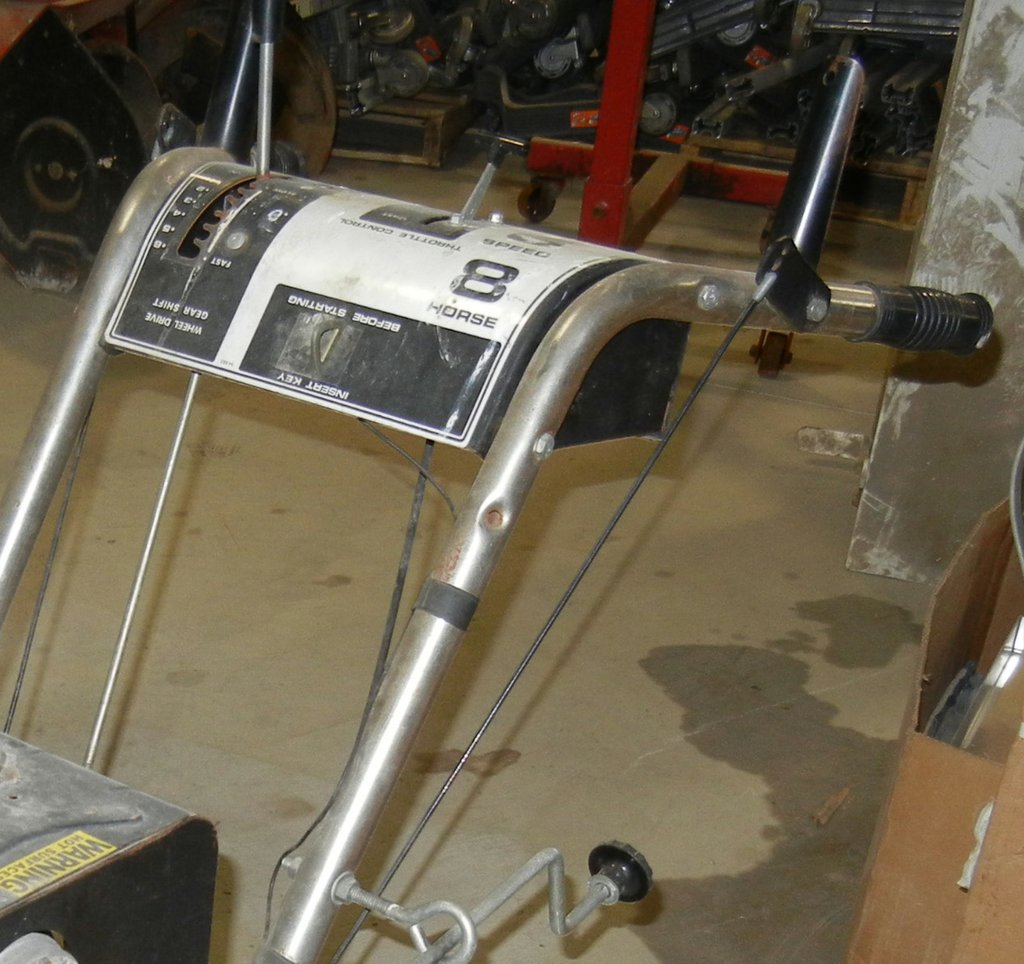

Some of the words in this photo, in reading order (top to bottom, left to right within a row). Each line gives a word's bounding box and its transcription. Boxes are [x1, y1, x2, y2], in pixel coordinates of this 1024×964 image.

[161, 224, 171, 233] 5
[340, 218, 394, 235] CONTROL
[152, 240, 163, 249] 6
[399, 232, 462, 252] THROTTLE
[482, 238, 552, 258] SPEED
[210, 256, 233, 269] FAST
[449, 258, 520, 303] 8
[151, 297, 181, 312] SHIFT
[182, 305, 209, 321] GEAR
[287, 294, 347, 318] STARTING
[144, 311, 172, 327] DRIVE
[351, 311, 402, 333] BEFORE
[427, 301, 499, 329] HORSE
[173, 318, 203, 336] WHEEL
[276, 372, 303, 386] KEY
[305, 380, 350, 400] INSERT
[61, 834, 86, 850] HOT
